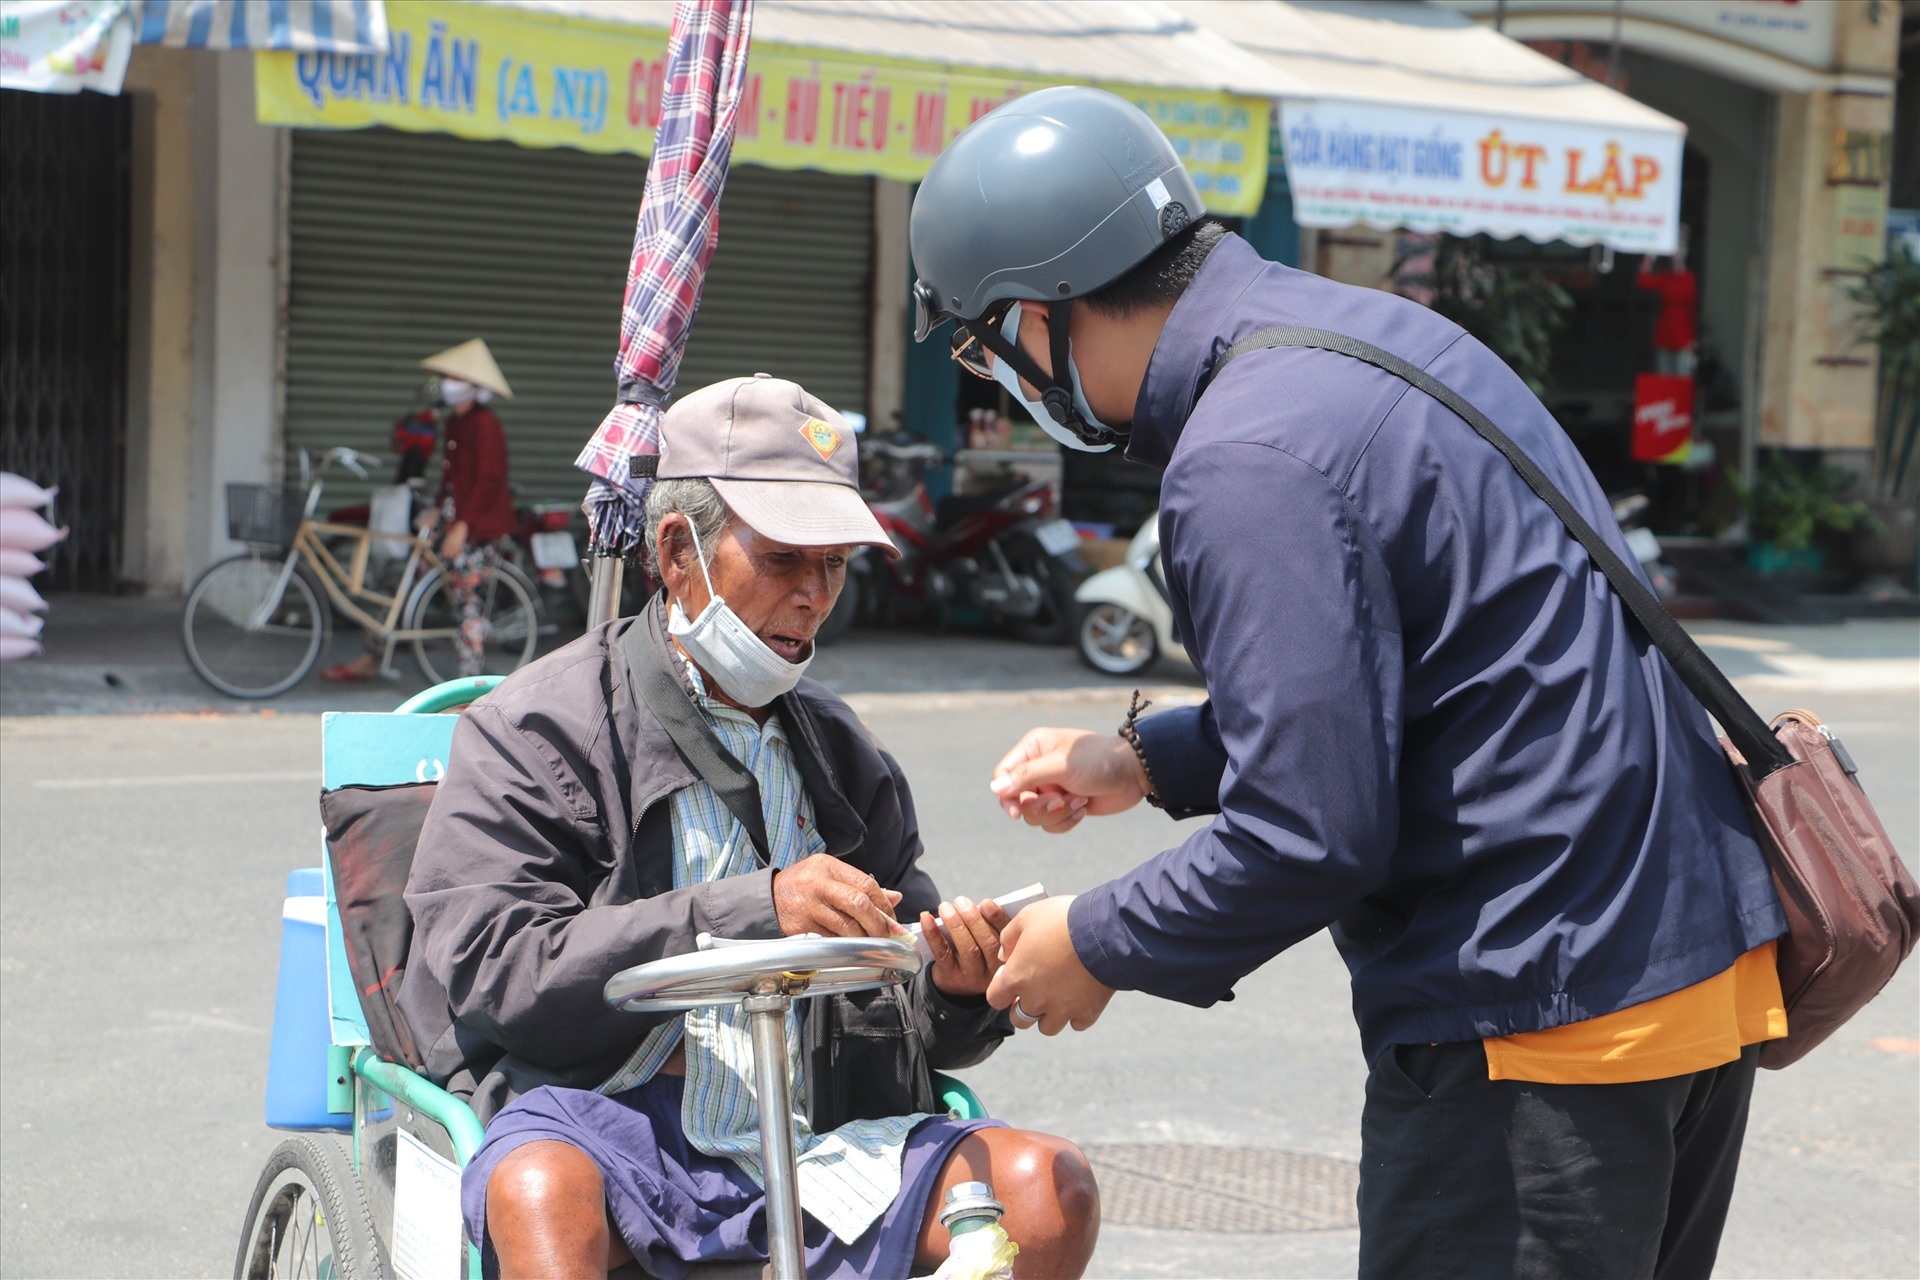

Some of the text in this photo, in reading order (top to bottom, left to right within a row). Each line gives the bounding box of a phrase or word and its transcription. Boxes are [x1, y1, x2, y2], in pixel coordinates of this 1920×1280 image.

[421, 19, 480, 113] ĂN
[497, 55, 540, 124] (A
[784, 59, 821, 144] HỦ
[831, 65, 890, 151] TIẾU
[1478, 127, 1548, 190] ÚT
[1562, 140, 1661, 209] LẬP
